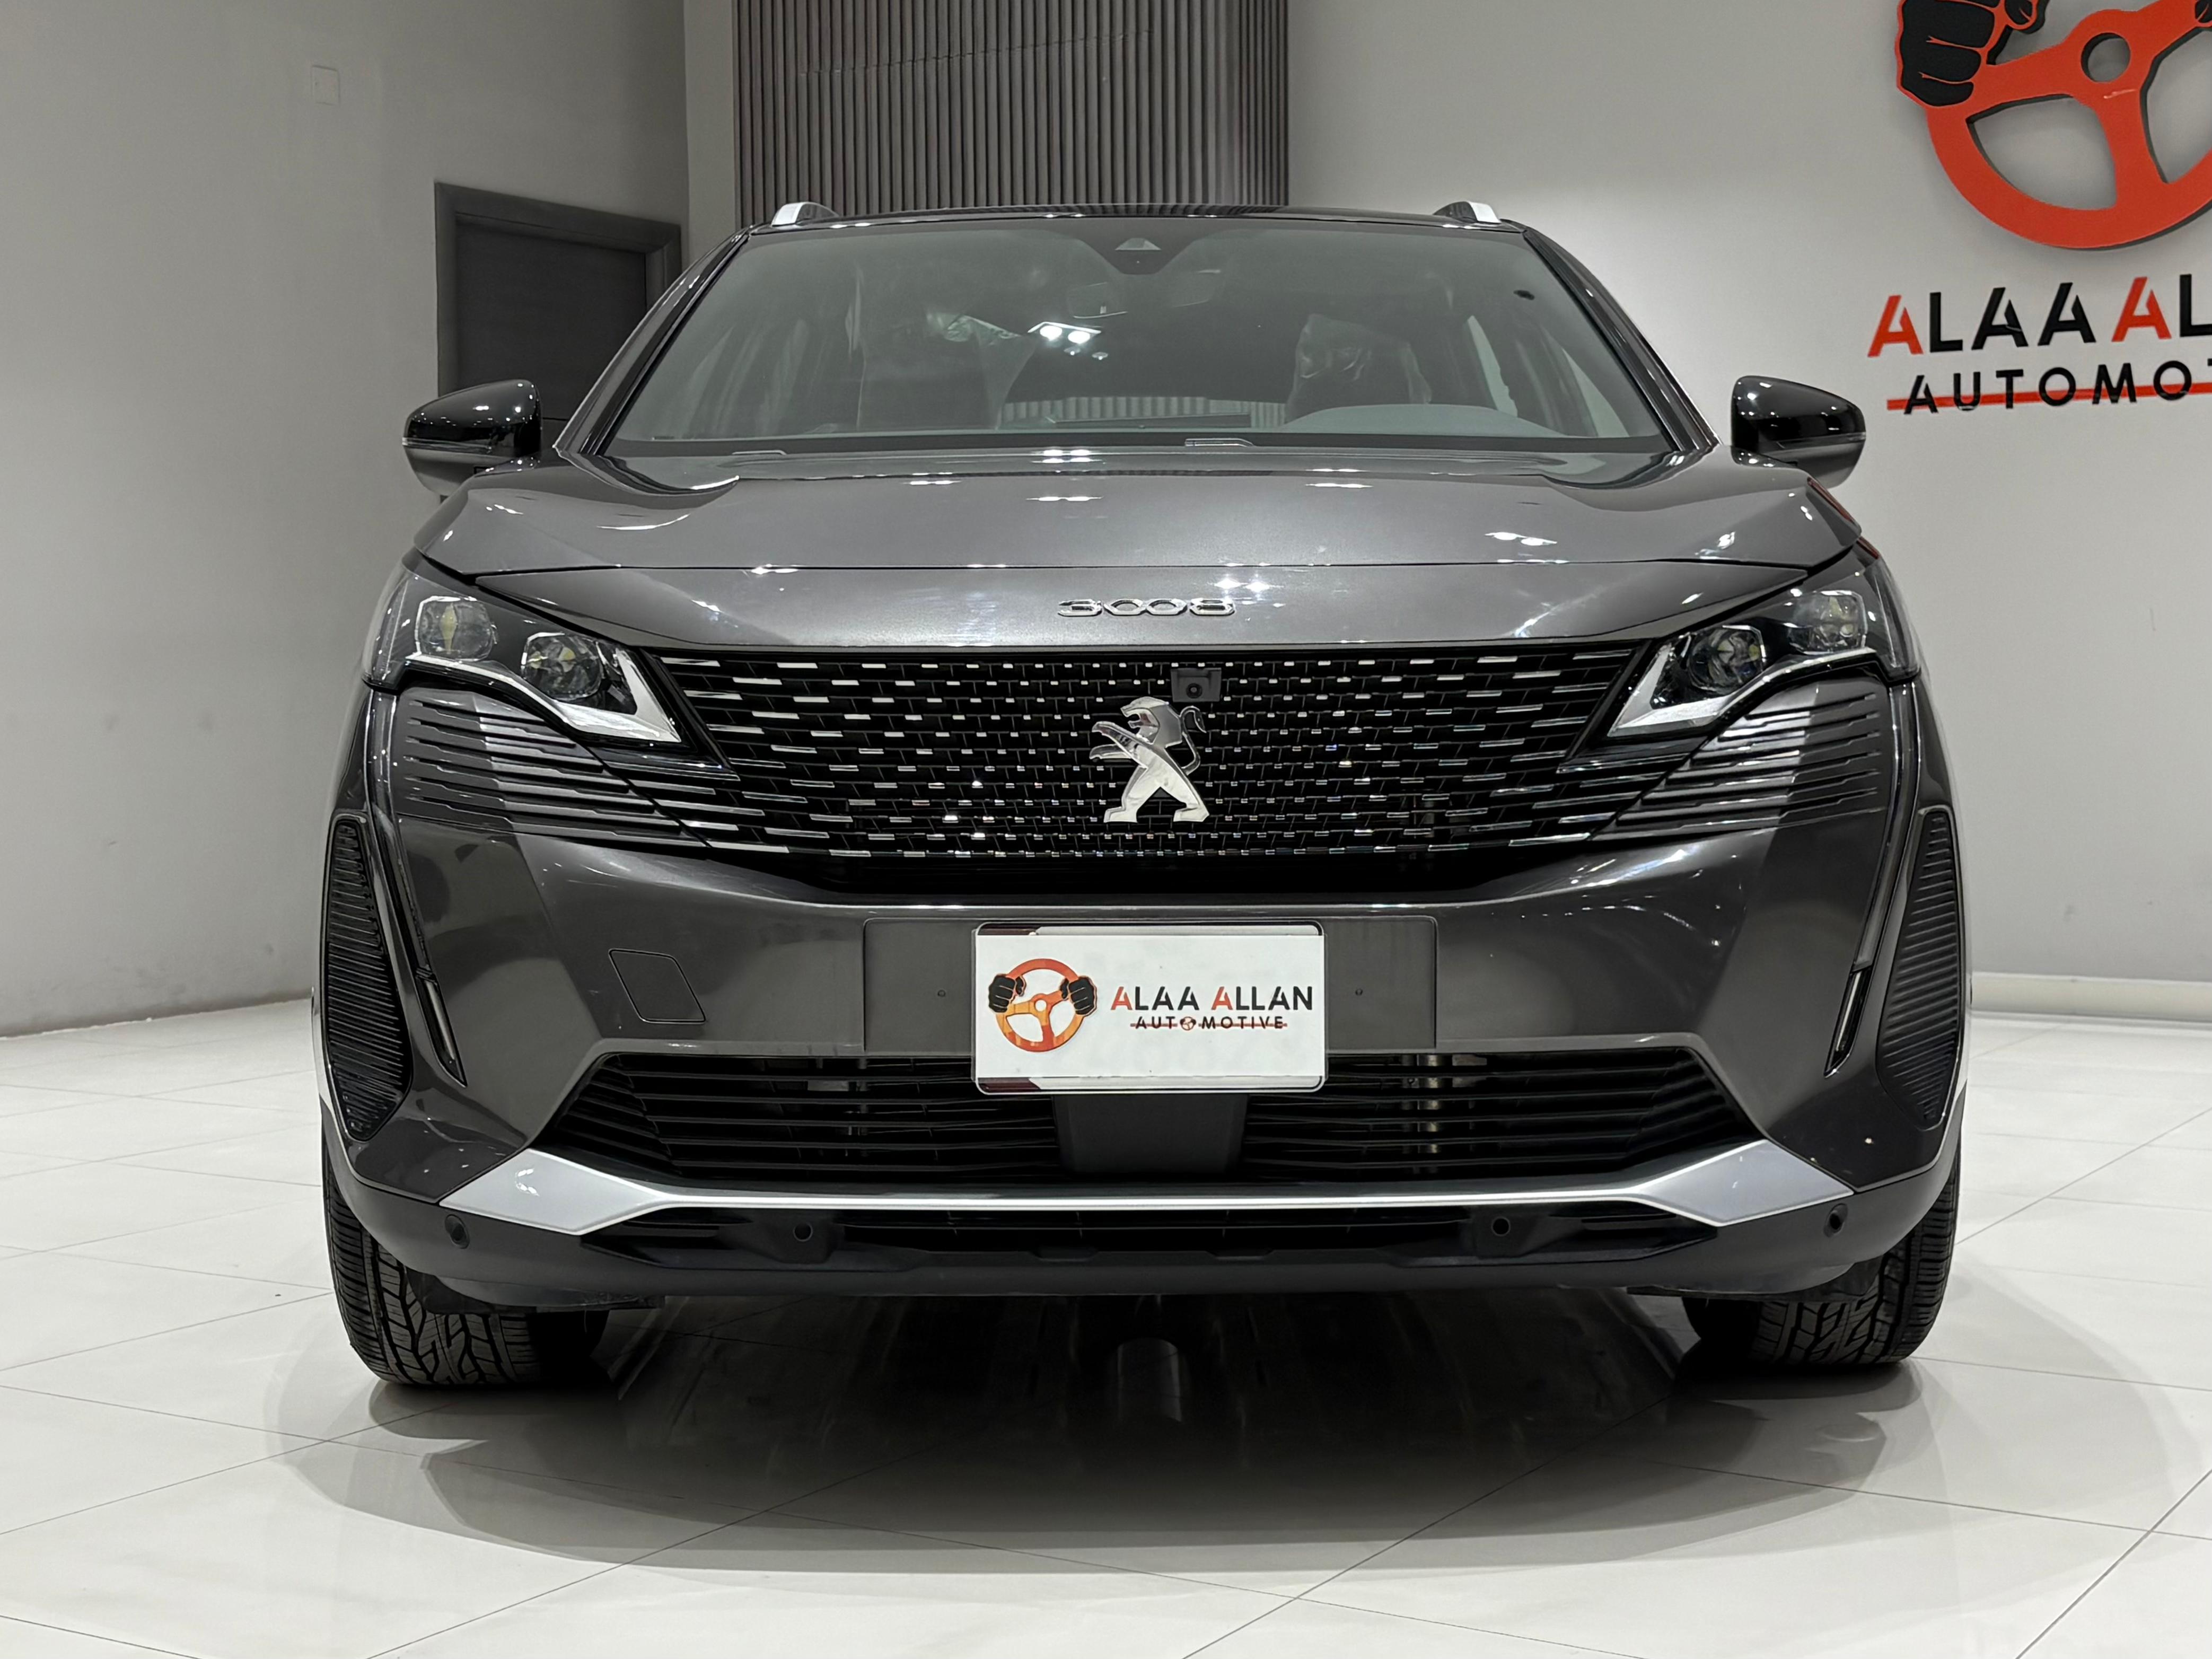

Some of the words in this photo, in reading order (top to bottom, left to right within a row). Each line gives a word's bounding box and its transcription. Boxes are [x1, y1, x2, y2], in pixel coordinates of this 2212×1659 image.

[1867, 282, 2096, 357] ALAA
[1903, 358, 2212, 415] AUTOMO
[1058, 599, 1236, 617] 3008
[1111, 986, 1200, 1011] ALAA
[1211, 986, 1312, 1011] ALLAN
